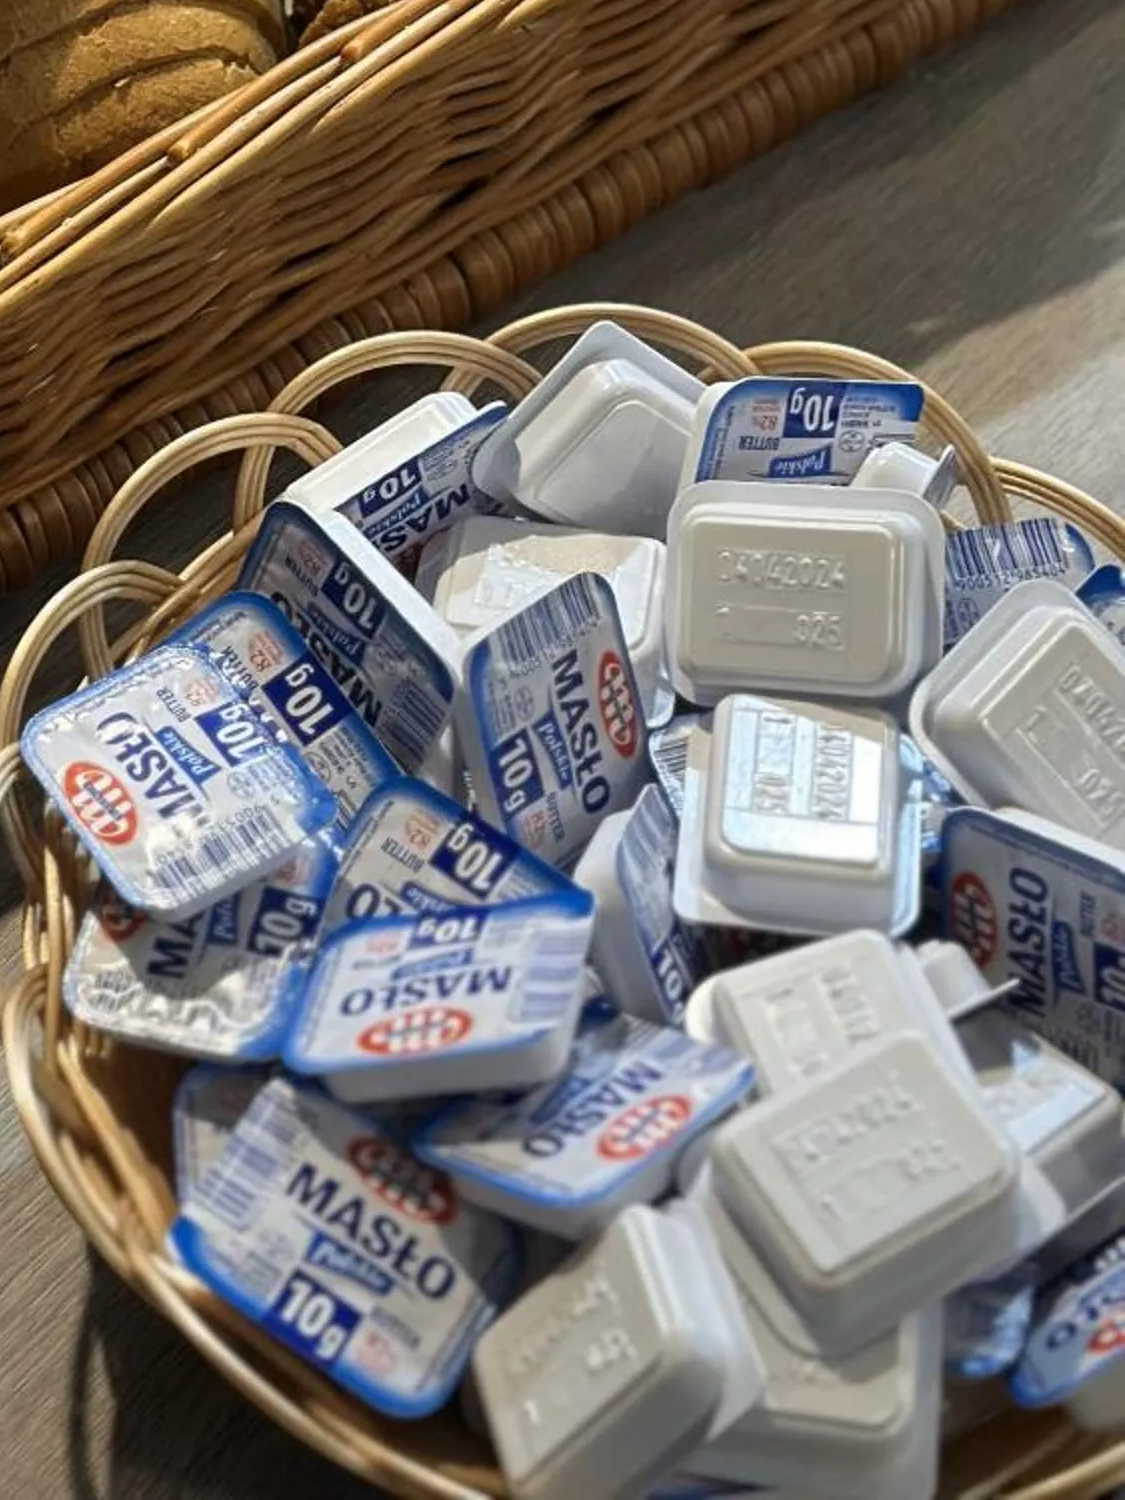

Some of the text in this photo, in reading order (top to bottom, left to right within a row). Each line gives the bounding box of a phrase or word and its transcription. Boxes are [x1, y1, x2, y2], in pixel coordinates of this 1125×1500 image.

[738, 435, 780, 451] BUTTER
[790, 387, 836, 432] 10g
[362, 466, 417, 503] 10g
[334, 562, 378, 630] 10g
[218, 701, 268, 758] 10g
[285, 662, 335, 736] 10g
[551, 648, 611, 815] MASŁO
[163, 730, 215, 777] Polskie
[498, 739, 532, 815] 10g
[538, 722, 572, 783] Polskie
[448, 822, 504, 898] 10g
[417, 916, 478, 943] 10g
[1007, 867, 1049, 1020] MASŁO
[340, 965, 513, 1017] MASŁO
[524, 1060, 663, 1158] MASŁO
[284, 1161, 456, 1300] MASŁO
[282, 1279, 347, 1360] 10g
